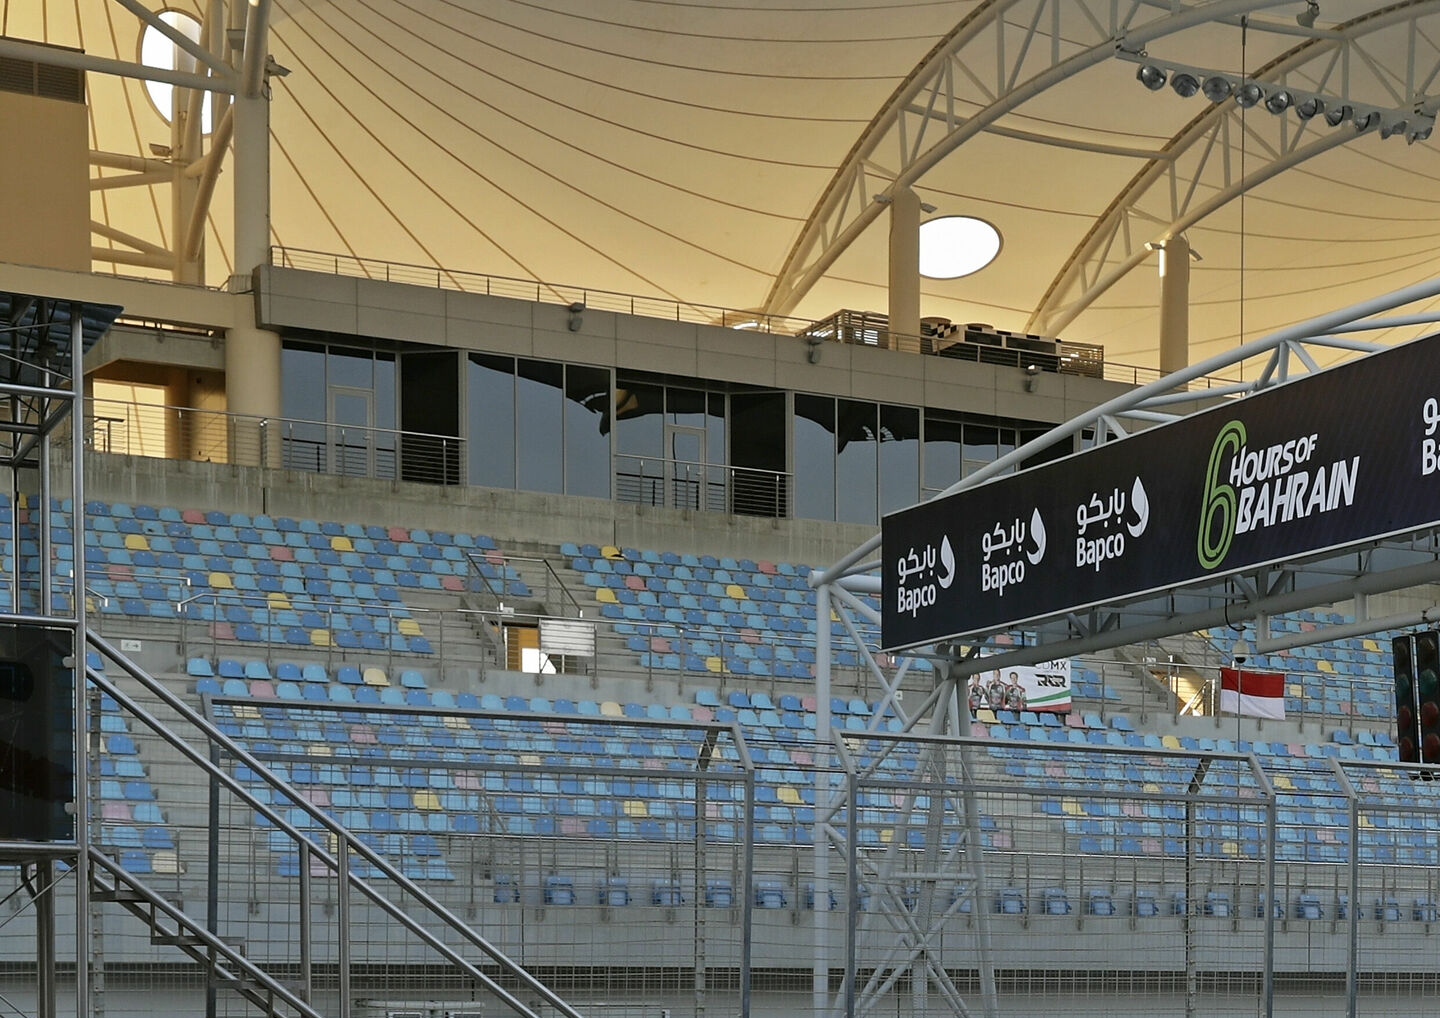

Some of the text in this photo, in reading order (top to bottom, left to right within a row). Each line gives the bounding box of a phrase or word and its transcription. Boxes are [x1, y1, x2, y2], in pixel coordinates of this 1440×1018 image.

[1076, 488, 1125, 535] بابكو
[1198, 420, 1247, 569] 6
[1235, 456, 1360, 535] BAHRAIN
[982, 518, 1025, 562] بابكو
[1076, 531, 1124, 572] Bapco
[898, 544, 936, 584] بابكو
[982, 560, 1025, 596] Bapco
[898, 582, 936, 617] Bapco
